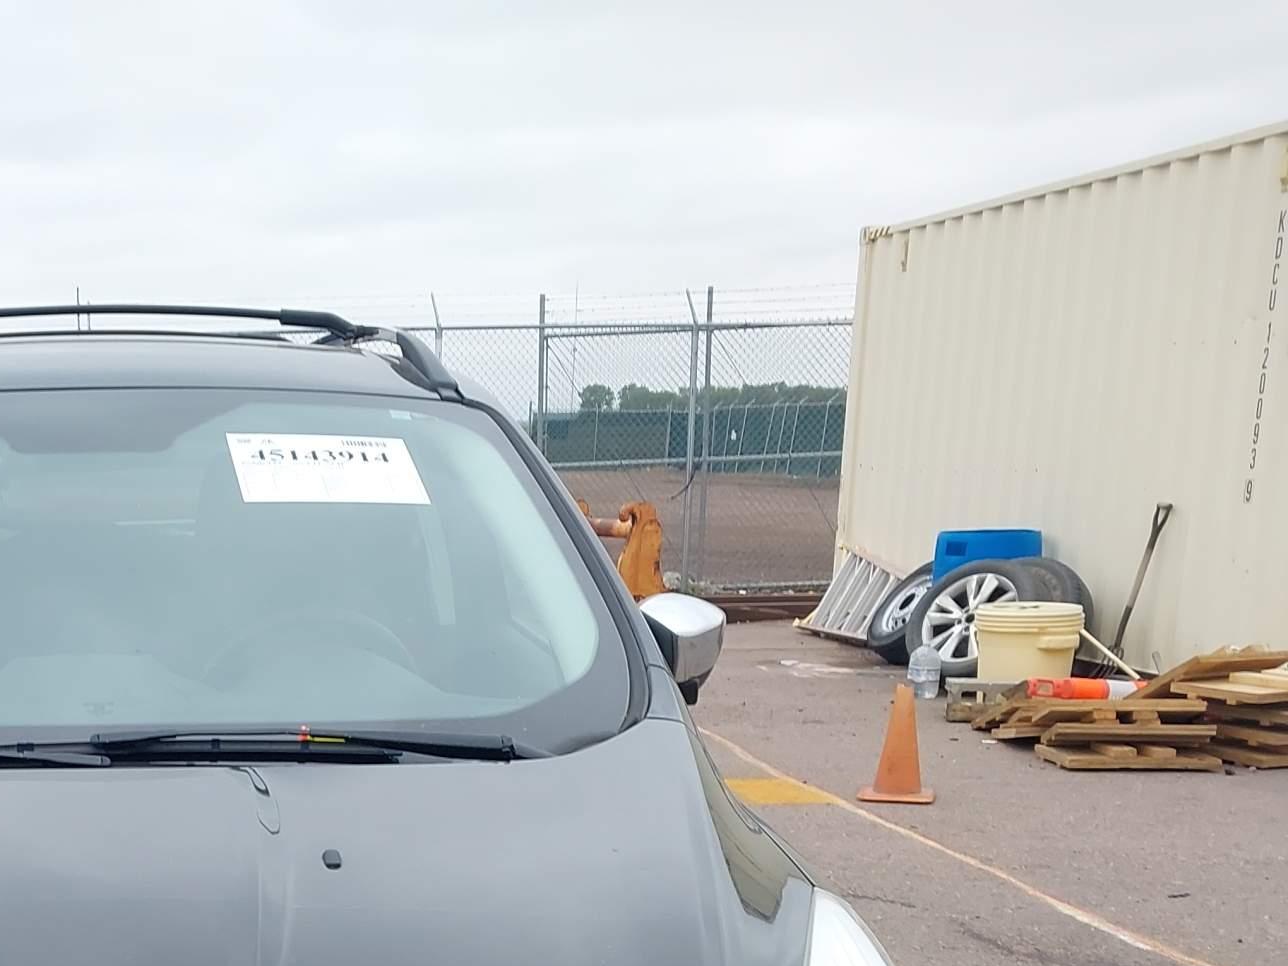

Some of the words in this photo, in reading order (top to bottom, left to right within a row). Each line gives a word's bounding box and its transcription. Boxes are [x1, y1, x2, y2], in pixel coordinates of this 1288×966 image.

[1268, 209, 1288, 312] KDCU
[1249, 321, 1272, 470] 120093
[251, 449, 389, 463] 45143914
[1245, 479, 1253, 502] 9
